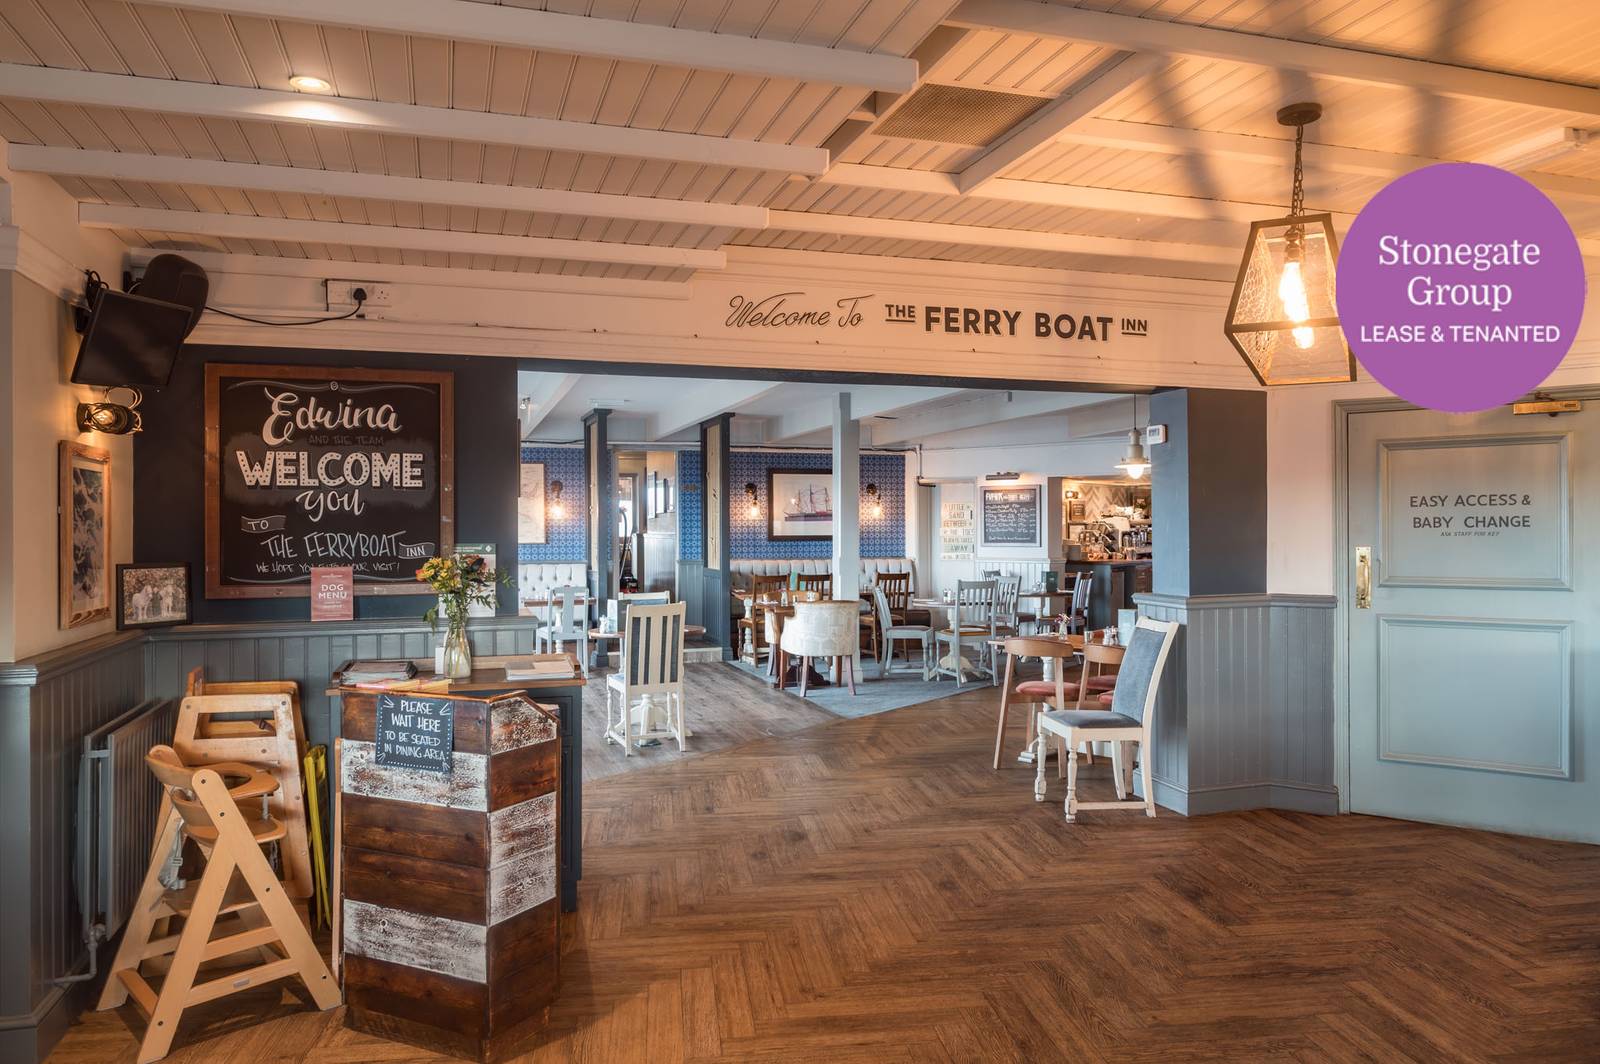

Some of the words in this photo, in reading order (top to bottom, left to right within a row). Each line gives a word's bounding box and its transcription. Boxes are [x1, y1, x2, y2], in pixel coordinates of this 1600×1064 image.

[725, 292, 832, 328] Welcome
[836, 294, 876, 328] To
[885, 304, 916, 319] THE
[924, 305, 1022, 336] FERRY
[1034, 312, 1113, 341] BOAT
[1121, 318, 1148, 333] INN
[262, 387, 402, 446] Edwina
[308, 434, 329, 445] AND
[356, 435, 384, 446] TEAM
[236, 450, 424, 488] WELCOME
[296, 489, 365, 522] you
[1410, 495, 1448, 507] EASY
[1454, 494, 1517, 506] ACCESS
[1521, 494, 1531, 506] &
[248, 519, 269, 531] TO
[1413, 516, 1453, 528] BABY
[1463, 515, 1531, 528] CHANGE
[260, 534, 297, 559] THE
[304, 530, 406, 560] FERRYBOAT
[406, 546, 425, 557] INN
[256, 563, 270, 573] WE
[272, 561, 294, 573] HOPE
[321, 583, 344, 591] DOG
[318, 591, 347, 600] MENU
[400, 699, 434, 714] PLEASE
[391, 712, 415, 727] WAIT
[416, 716, 441, 732] HERE
[385, 730, 395, 740] TO
[398, 731, 410, 742] BE
[411, 733, 441, 746] SEATED
[384, 743, 392, 753] IN
[395, 744, 422, 758] DINING
[423, 748, 446, 761] AREA
